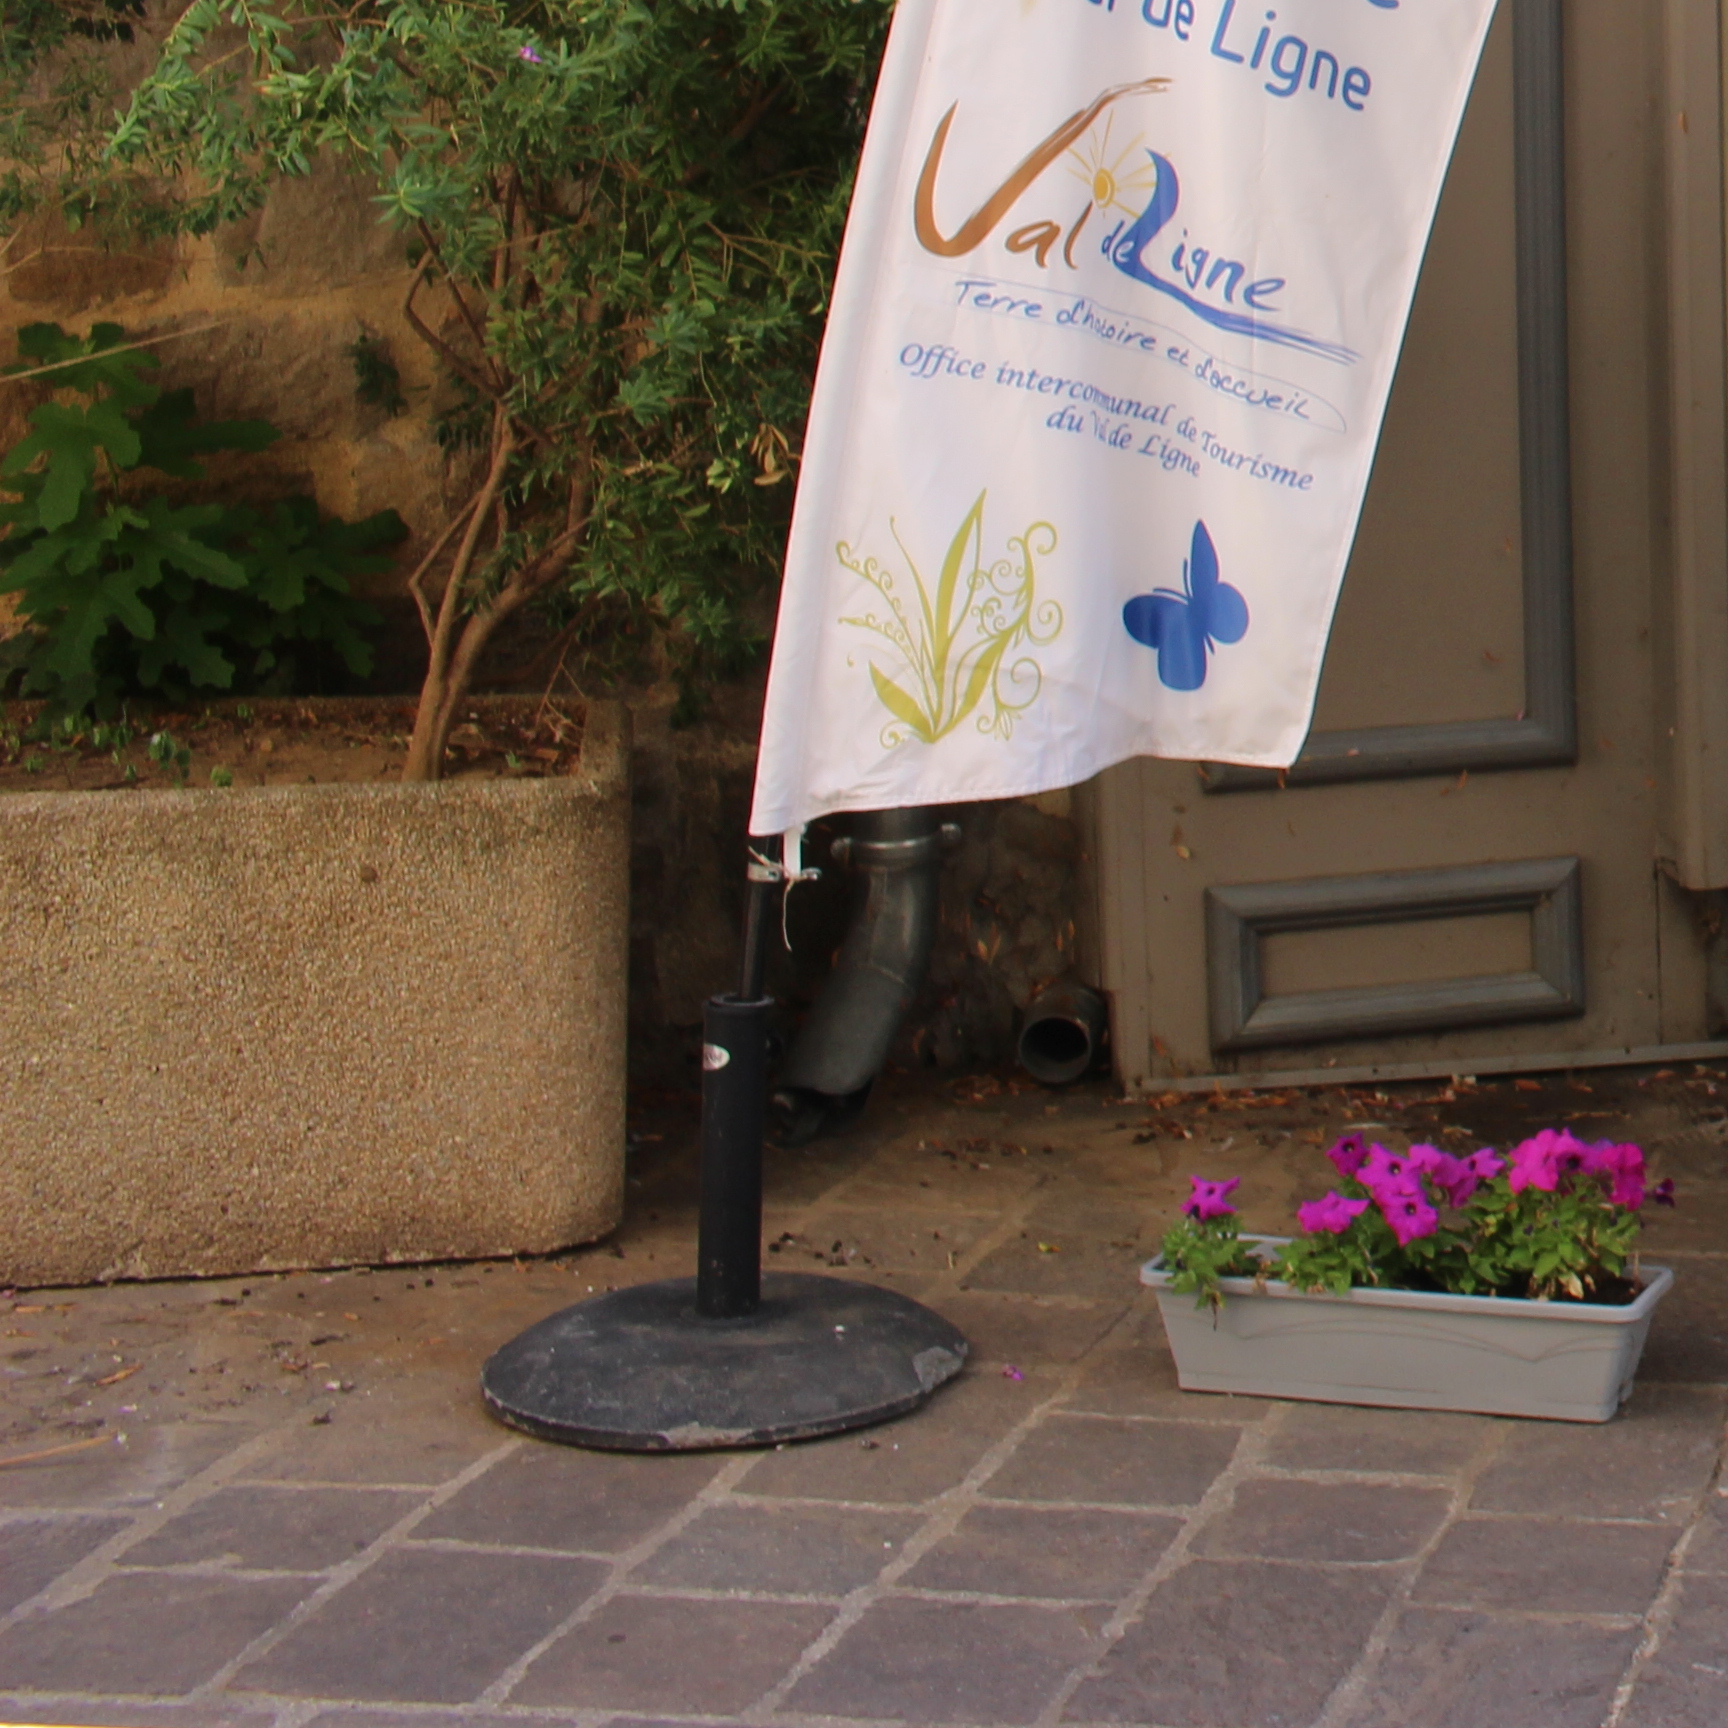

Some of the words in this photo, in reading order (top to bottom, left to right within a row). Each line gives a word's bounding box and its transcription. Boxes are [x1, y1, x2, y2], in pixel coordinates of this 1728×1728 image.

[914, 77, 1173, 270] Val
[1100, 219, 1133, 264] de
[1110, 147, 1325, 337] Ligne
[899, 342, 987, 380] Office
[1176, 415, 1199, 443] de
[1201, 430, 1314, 492] Tourisme
[954, 280, 1044, 319] Terre
[1166, 345, 1190, 368] et
[1194, 356, 1311, 421] d'accueil
[1046, 404, 1085, 433] du
[1107, 423, 1133, 450] de
[1137, 434, 1201, 478] Ligne
